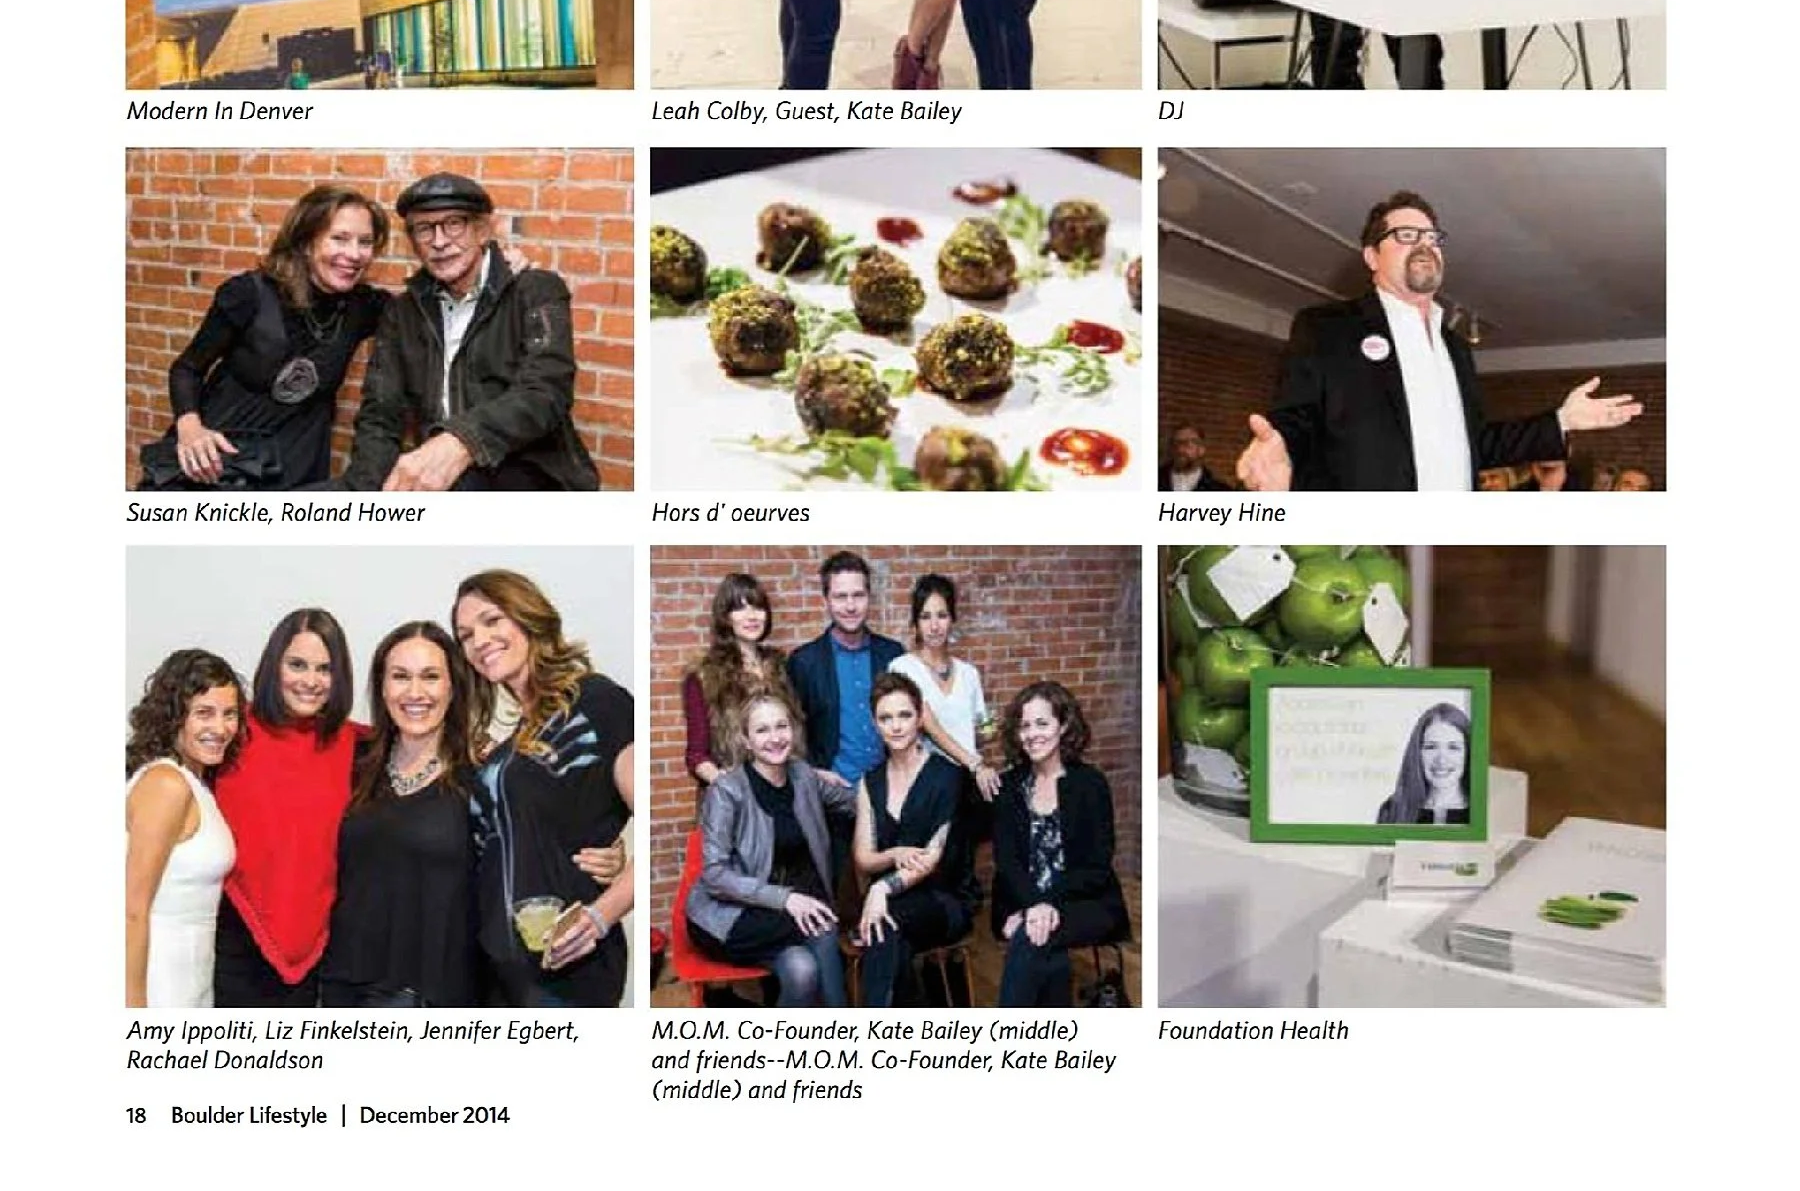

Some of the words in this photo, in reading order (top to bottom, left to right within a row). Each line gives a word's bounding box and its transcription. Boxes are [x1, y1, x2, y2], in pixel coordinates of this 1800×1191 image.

[126, 100, 208, 120] Modern
[214, 100, 233, 120] In
[239, 100, 314, 120] Denver
[651, 100, 700, 120] Leah
[707, 100, 768, 125] Colby,
[776, 100, 840, 124] Guest,
[847, 100, 894, 120] Kate
[900, 100, 963, 125] Bailey
[1158, 100, 1185, 120] DJ
[126, 502, 188, 522] Susan
[194, 501, 273, 526] Knickle,
[281, 501, 353, 522] Roland
[358, 502, 426, 522] Hower
[652, 502, 700, 522] Hors
[706, 502, 726, 522] d'
[731, 507, 810, 522] oeurves
[1158, 502, 1233, 526] Harvey
[1238, 502, 1286, 522] Hine
[125, 1020, 176, 1045] Amy
[181, 1020, 258, 1045] Ippoliti,
[265, 1020, 294, 1040] Liz
[299, 1019, 413, 1044] Finkelstein,
[419, 1019, 502, 1045] Jennifer
[507, 1020, 579, 1045] Egbert,
[651, 1020, 730, 1040] M.O.M.
[737, 1020, 860, 1043] Co-Founder,
[867, 1020, 914, 1040] Kate
[921, 1020, 984, 1045] Bailey
[989, 1019, 1078, 1042] (middle)
[1158, 1020, 1274, 1040] Foundation
[1280, 1019, 1349, 1040] Health
[126, 1049, 209, 1069] Rachael
[214, 1049, 323, 1069] Donaldson
[651, 1049, 691, 1069] and
[695, 1049, 863, 1074] friends--M.O.M.
[871, 1049, 993, 1073] Co-Founder,
[1000, 1049, 1048, 1069] Kate
[1054, 1049, 1117, 1074] Bailey
[652, 1079, 742, 1102] (middle)
[748, 1079, 787, 1099] and
[792, 1079, 863, 1104] friends
[125, 1107, 147, 1124] 18
[172, 1105, 245, 1124] Boulder
[249, 1105, 328, 1128] Lifestyle
[360, 1105, 460, 1124] December
[462, 1106, 511, 1124] 2014
